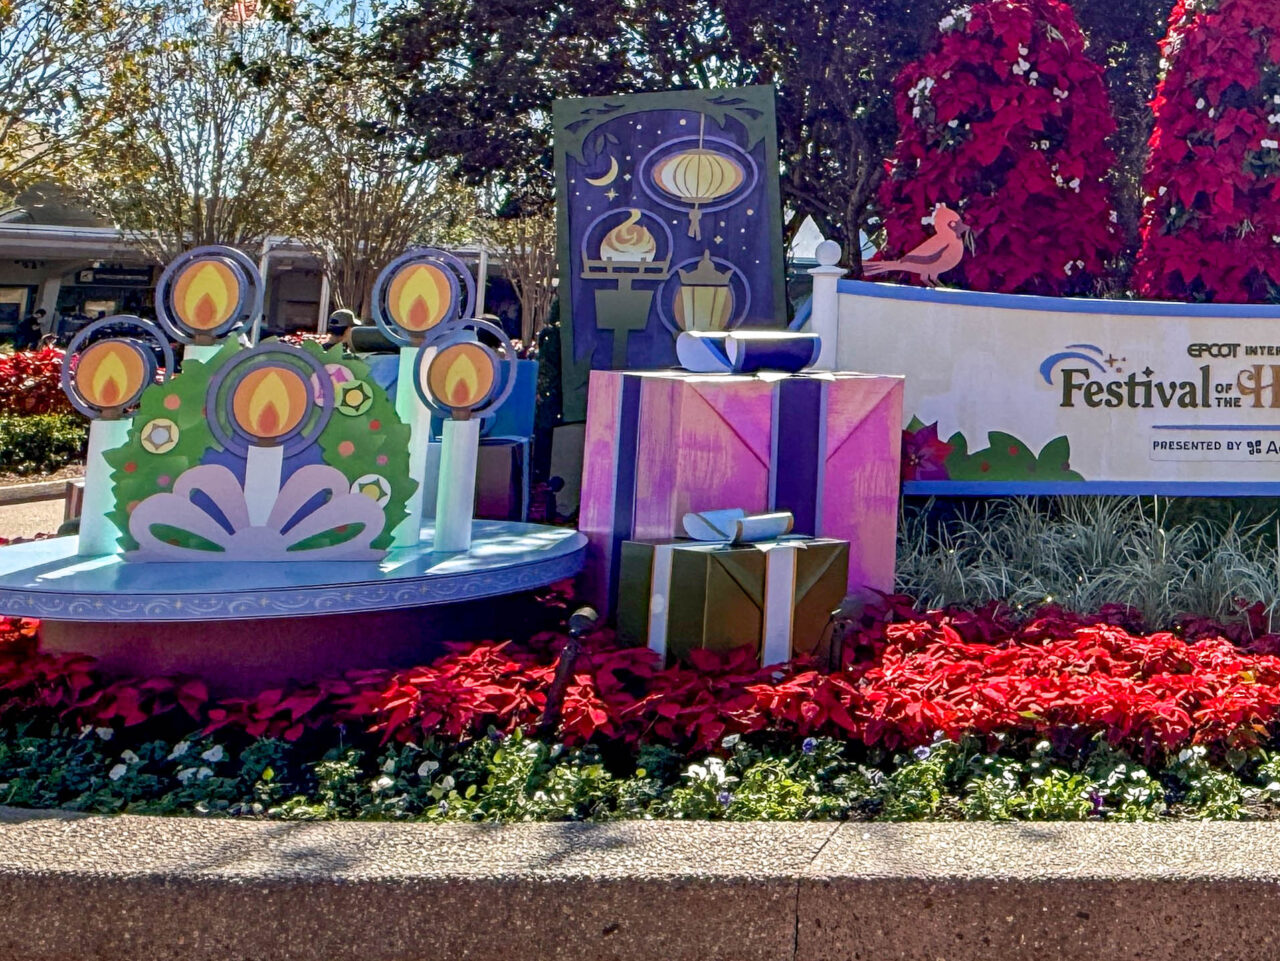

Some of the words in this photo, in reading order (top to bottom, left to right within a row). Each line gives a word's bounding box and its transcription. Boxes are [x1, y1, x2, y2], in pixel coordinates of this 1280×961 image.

[1187, 343, 1241, 358] EPCOT
[1059, 364, 1212, 409] Festival
[1214, 383, 1234, 394] OF
[1214, 397, 1242, 408] THE
[1152, 440, 1222, 451] PRESENTED
[1226, 441, 1242, 451] BY
